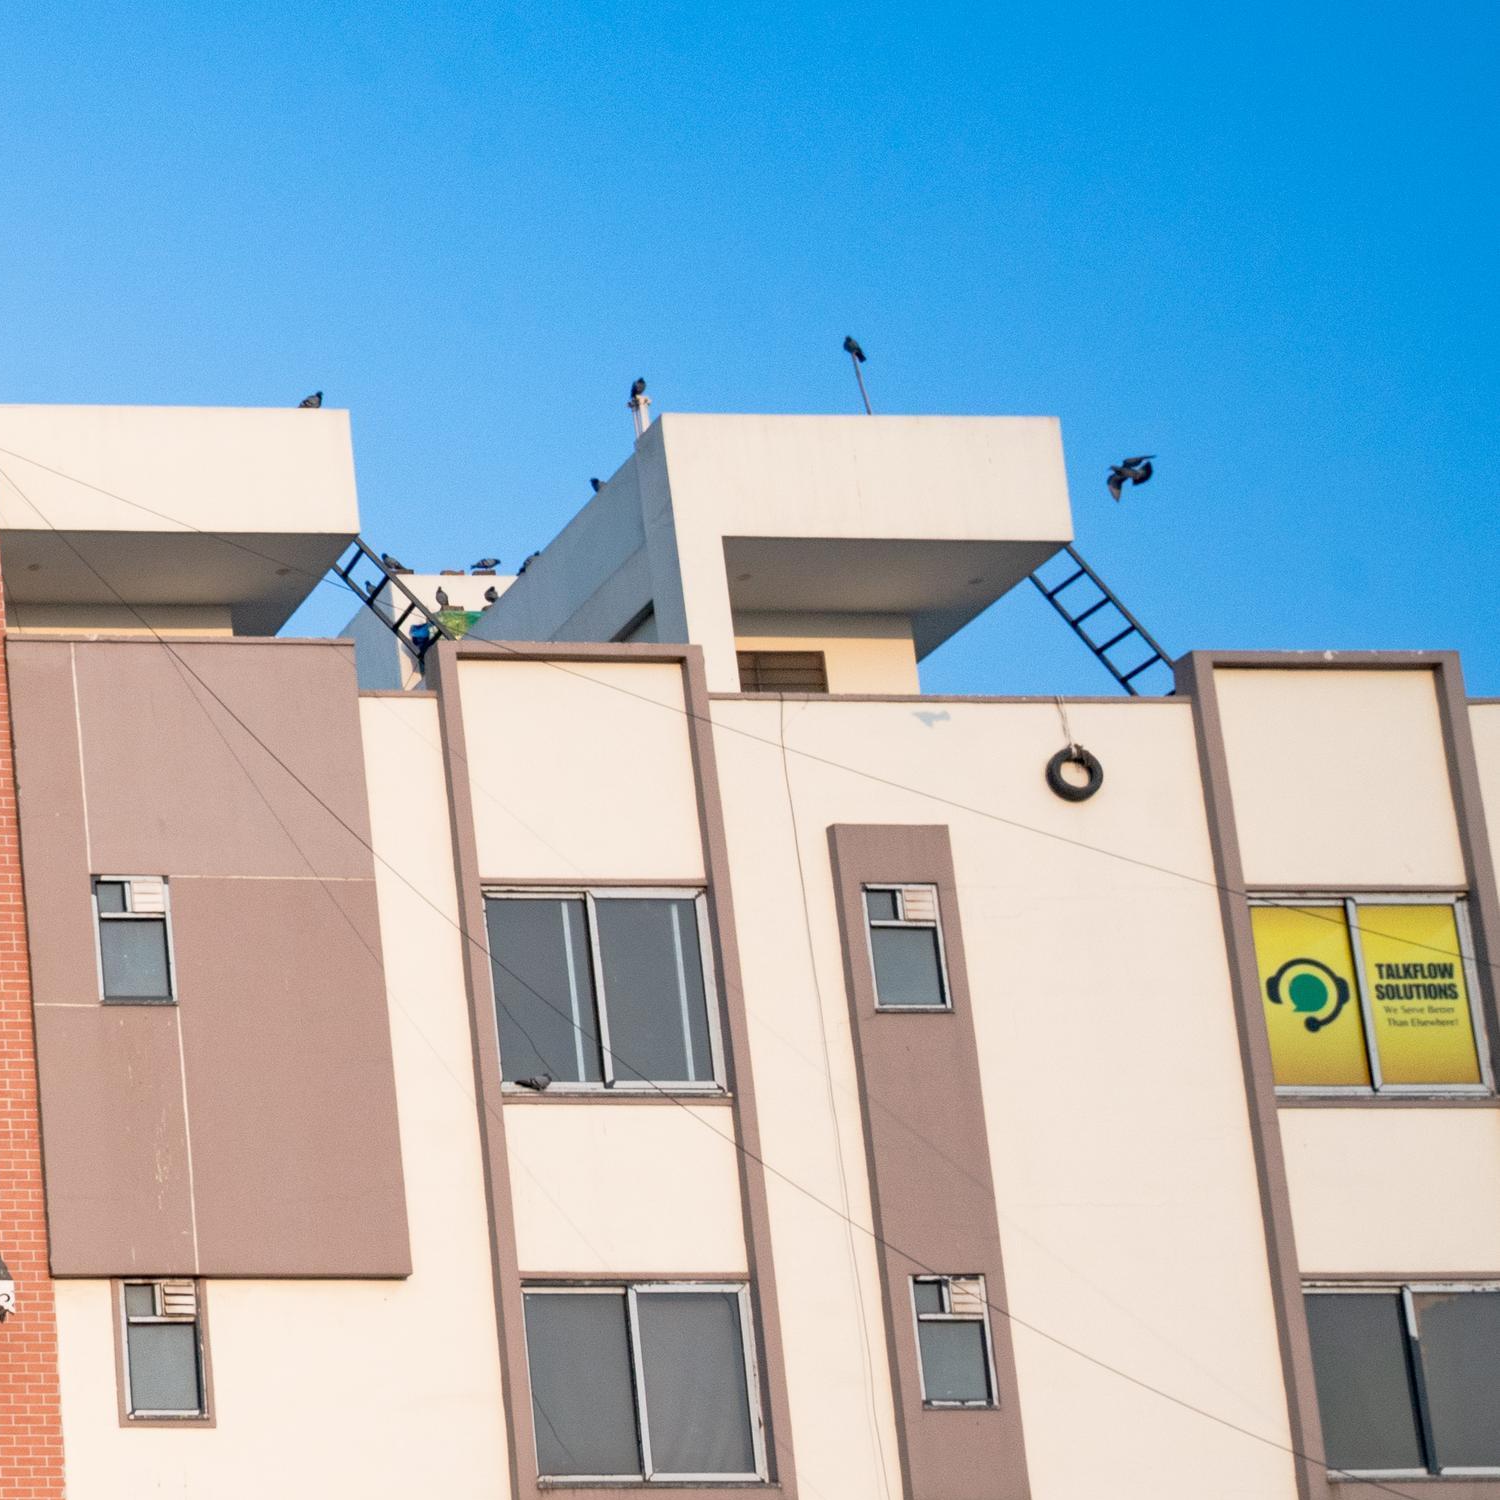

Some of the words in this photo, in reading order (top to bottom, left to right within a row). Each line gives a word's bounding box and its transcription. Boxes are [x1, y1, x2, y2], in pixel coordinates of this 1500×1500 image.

[1375, 962, 1454, 979] TALKFLOW
[1375, 983, 1459, 1001] SOLUTIONS
[1387, 1018, 1409, 1027] Than
